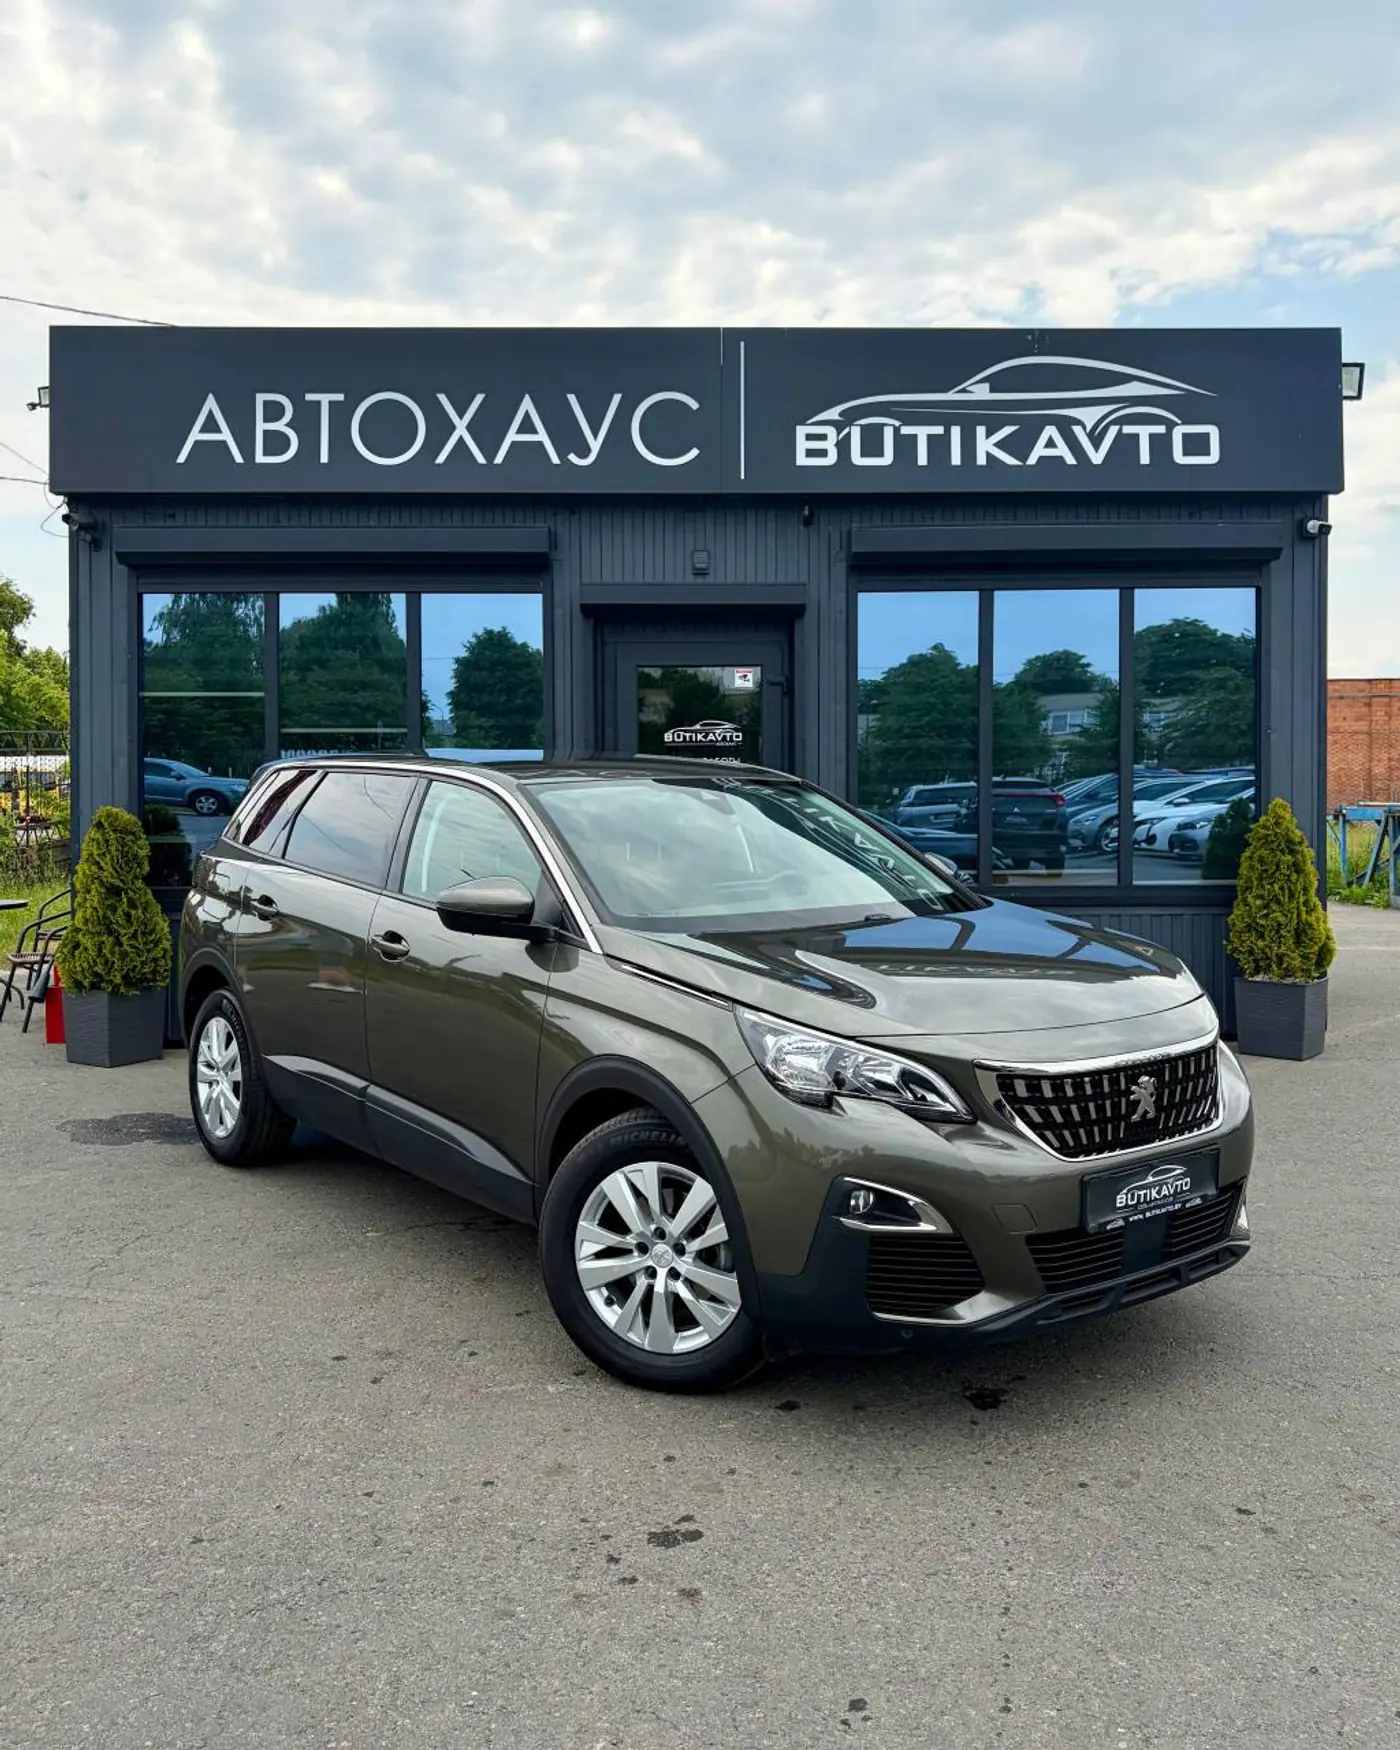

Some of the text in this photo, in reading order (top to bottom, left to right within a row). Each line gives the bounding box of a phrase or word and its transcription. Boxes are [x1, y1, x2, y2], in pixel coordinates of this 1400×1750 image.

[176, 391, 700, 467] АВТОХАУС
[795, 424, 1221, 467] BUTIKAVTO
[664, 732, 743, 742] BUTIKAVTO
[1116, 1178, 1190, 1207] BUTIKAVTO
